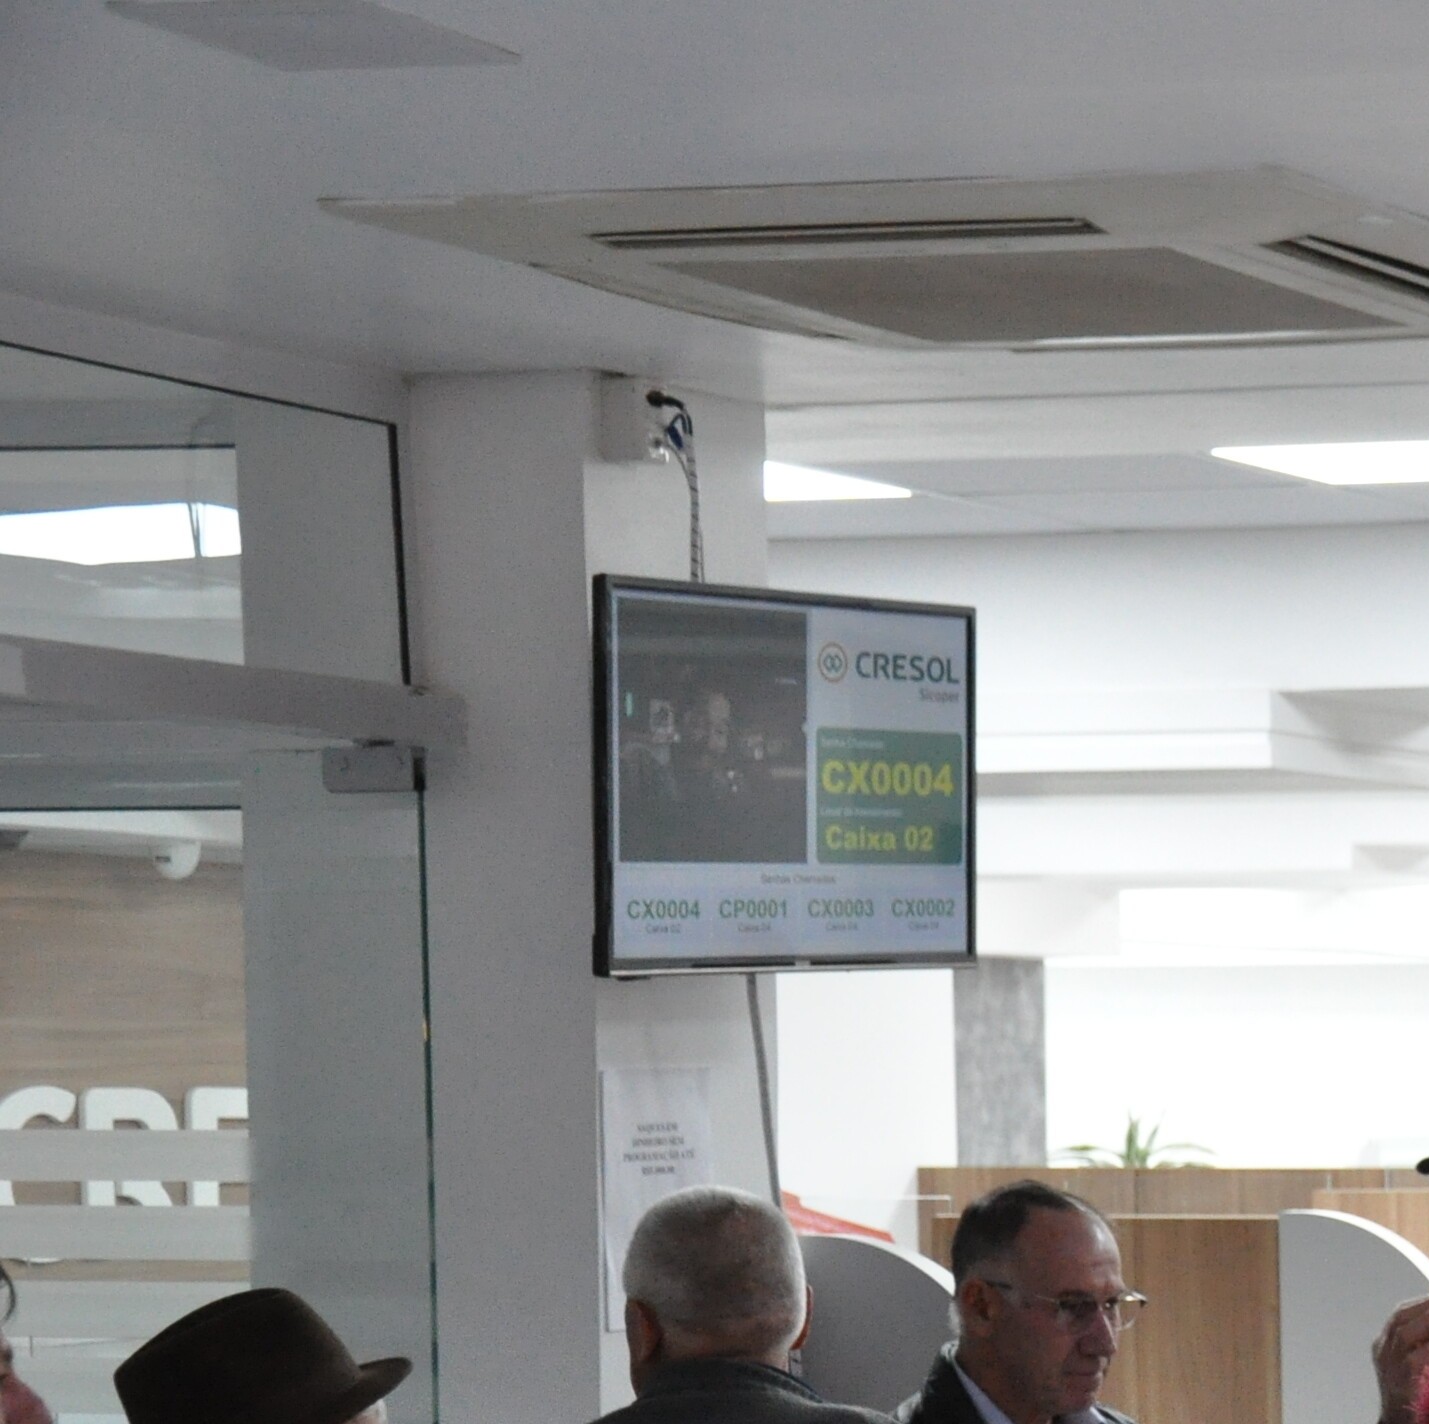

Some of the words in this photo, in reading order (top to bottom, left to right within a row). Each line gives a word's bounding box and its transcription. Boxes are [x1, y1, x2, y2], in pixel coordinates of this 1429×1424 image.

[856, 651, 960, 684] CRESOL
[821, 759, 954, 797] CX0004
[825, 825, 897, 851] Caixa
[904, 825, 935, 852] 02
[627, 899, 700, 920] CX0004
[719, 899, 788, 920] CP0001
[808, 898, 875, 919] CX0003
[891, 898, 956, 919] CX0002
